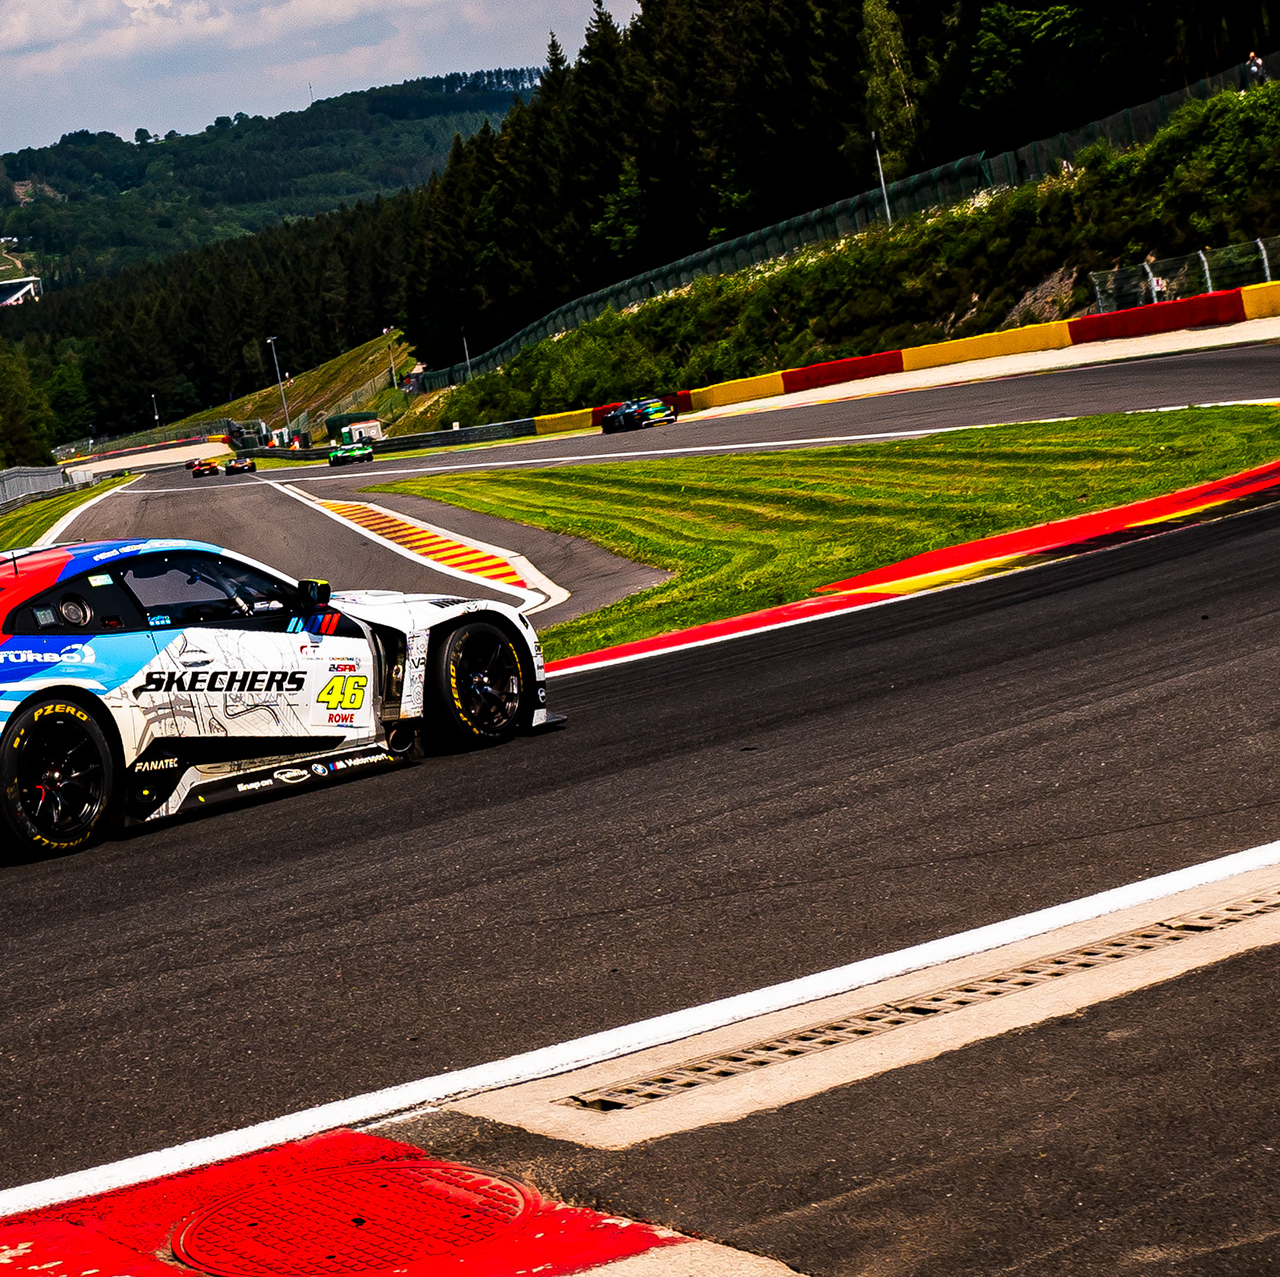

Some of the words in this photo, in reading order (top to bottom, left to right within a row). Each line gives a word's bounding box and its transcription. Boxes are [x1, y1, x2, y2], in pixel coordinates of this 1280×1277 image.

[137, 670, 307, 694] SKECHERS
[316, 675, 368, 710] 46
[328, 713, 355, 723] ROWE
[135, 758, 178, 772] FANATEC
